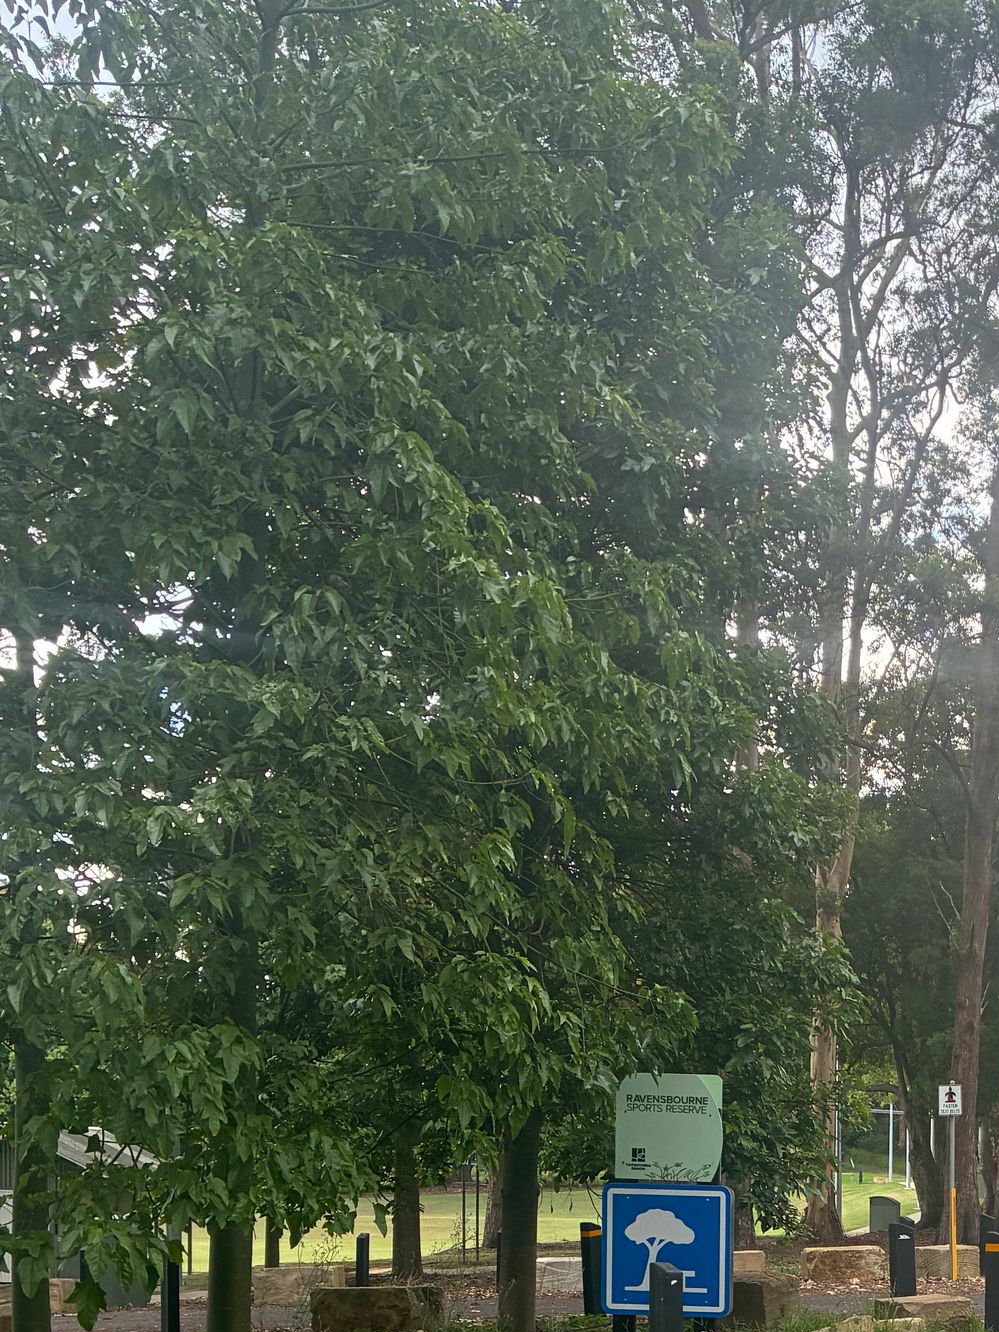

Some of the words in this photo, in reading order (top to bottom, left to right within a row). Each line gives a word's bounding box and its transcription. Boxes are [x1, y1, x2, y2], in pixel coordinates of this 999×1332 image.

[626, 1094, 709, 1105] RAVENSBOURNE
[626, 1103, 663, 1113] SPORTS
[665, 1104, 707, 1114] RESERVE
